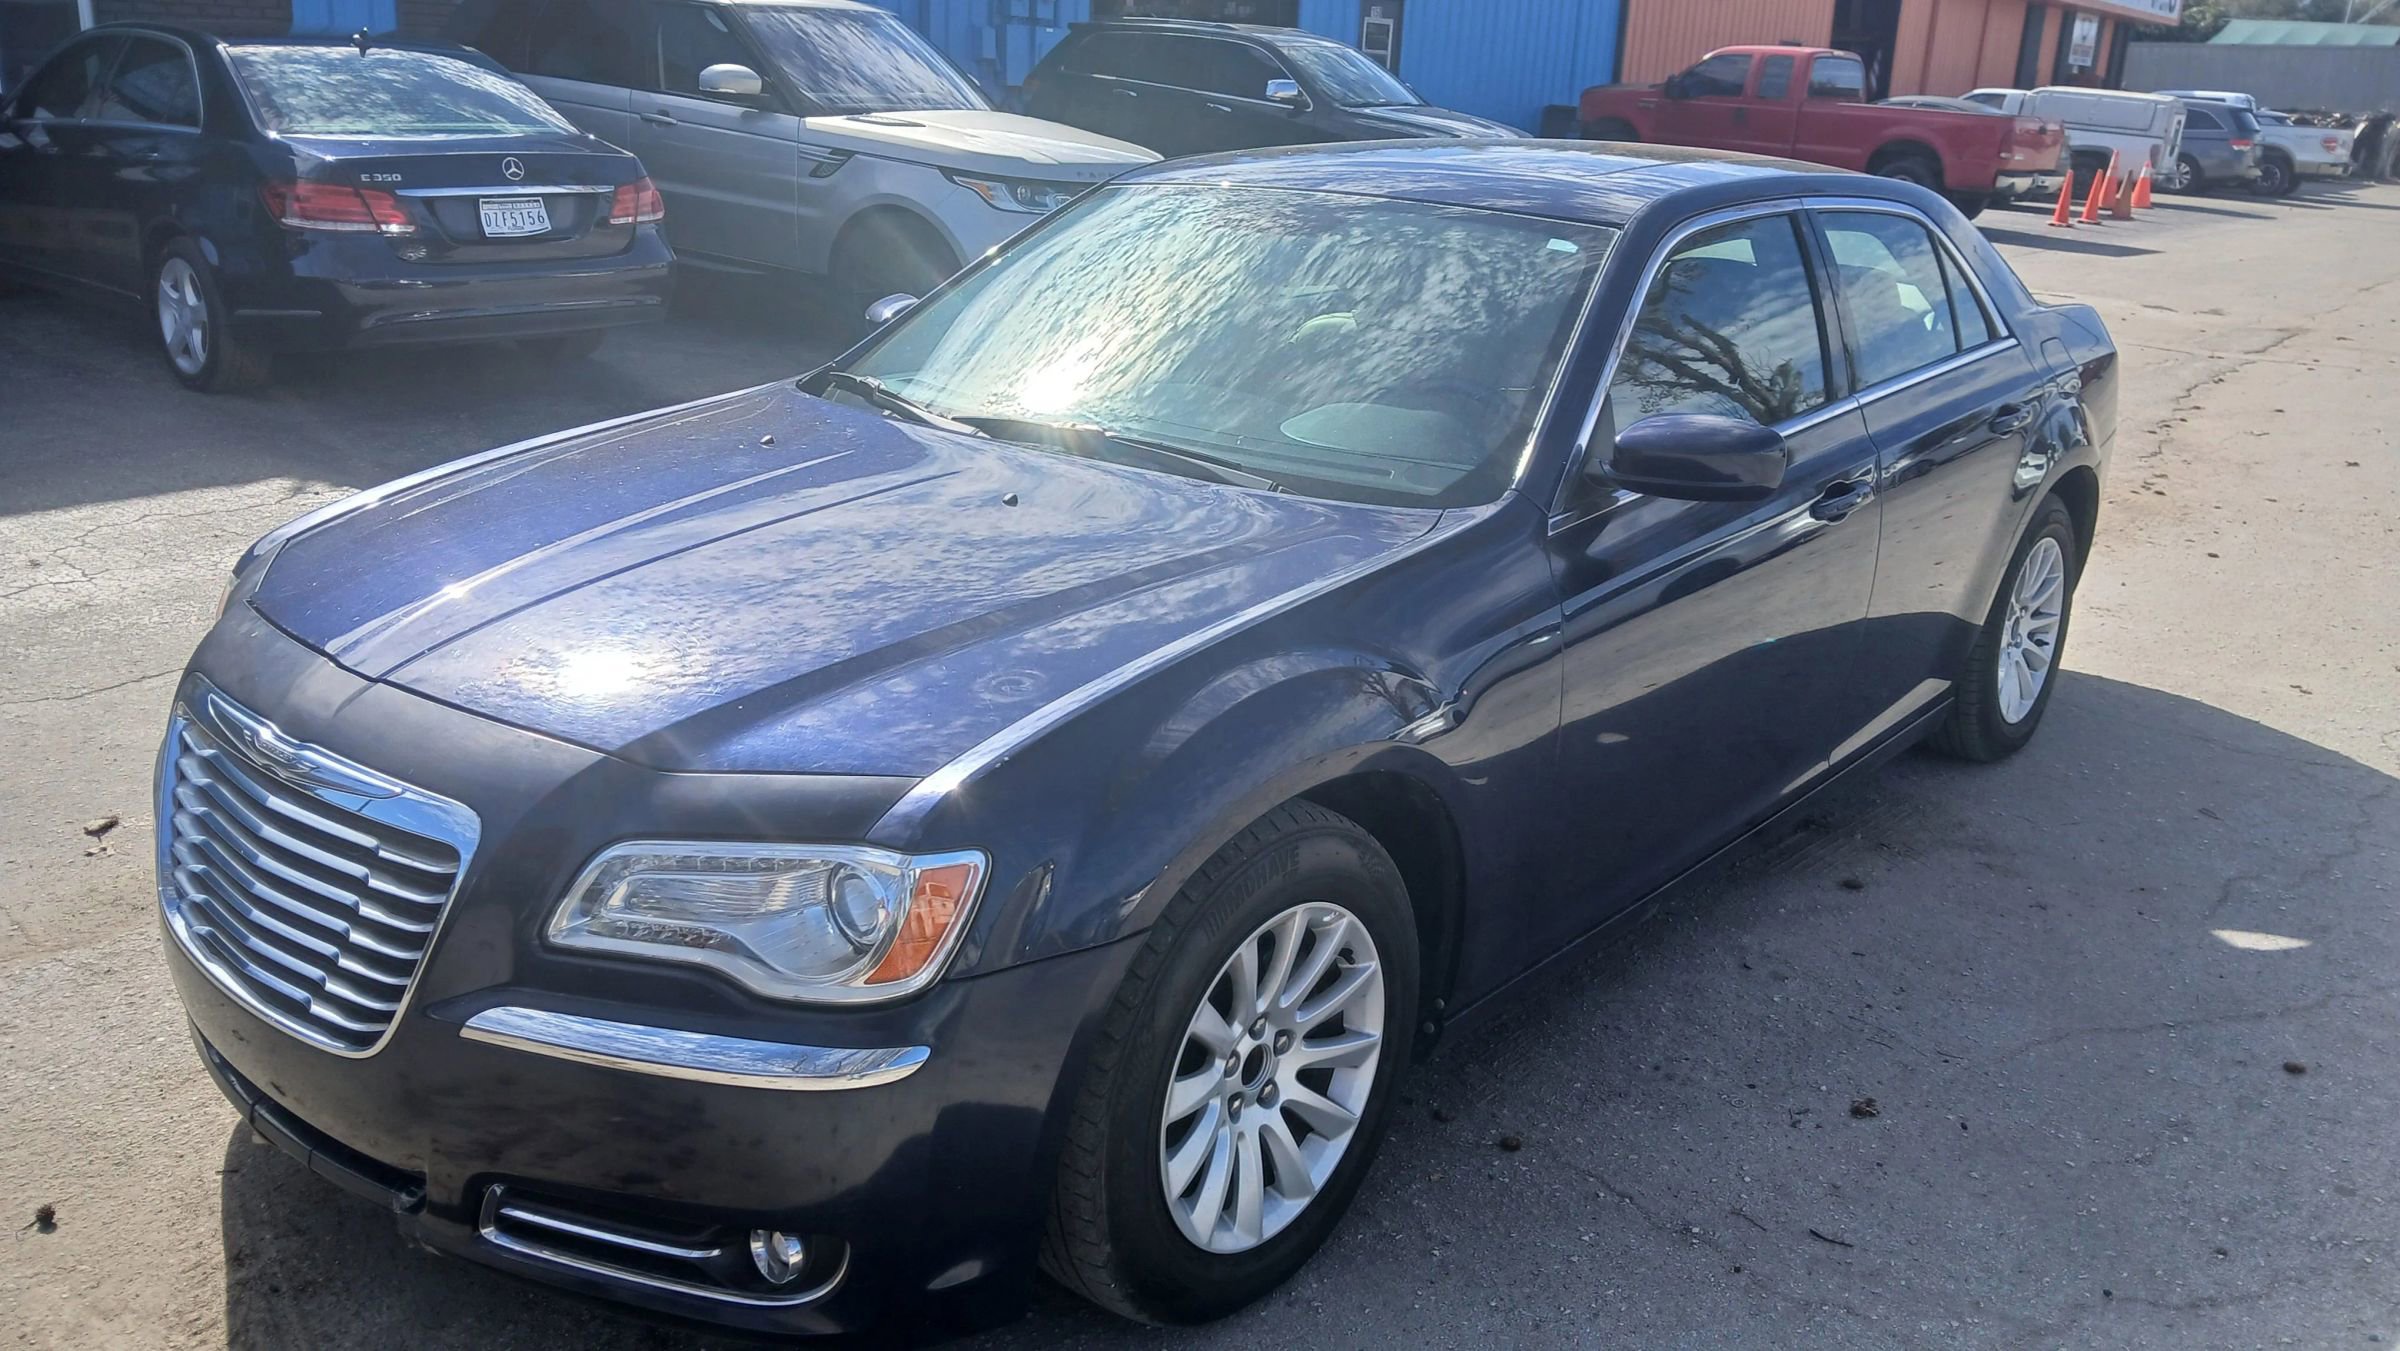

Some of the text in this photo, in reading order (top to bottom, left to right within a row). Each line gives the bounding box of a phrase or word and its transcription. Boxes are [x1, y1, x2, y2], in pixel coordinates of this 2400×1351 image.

[360, 173, 402, 182] E 350
[484, 210, 545, 227] DZF5156
